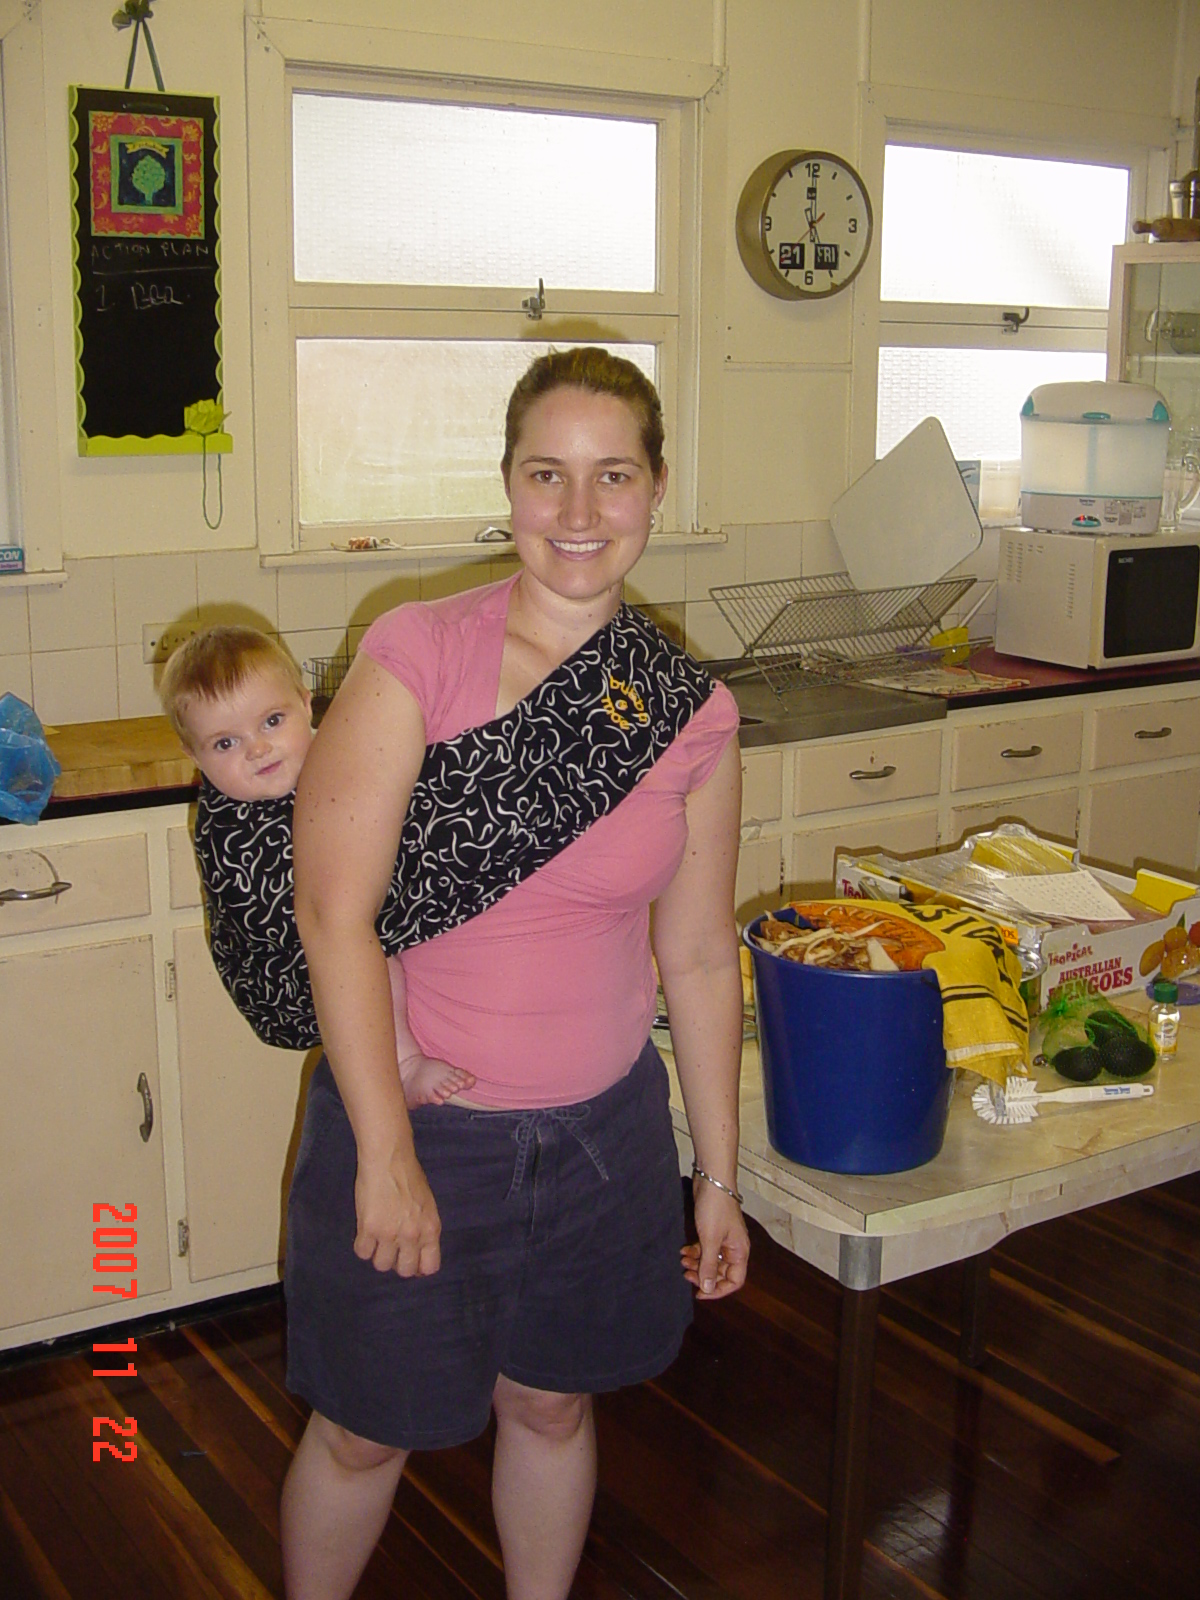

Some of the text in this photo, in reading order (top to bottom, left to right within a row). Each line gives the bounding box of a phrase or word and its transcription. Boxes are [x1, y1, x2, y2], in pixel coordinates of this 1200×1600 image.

[805, 163, 820, 178] 12
[848, 218, 857, 233] 3
[91, 241, 209, 265] ACTION PLAN
[780, 245, 801, 265] 21
[816, 246, 836, 263] FRI
[804, 270, 814, 286] 6
[1058, 956, 1122, 985] AUSTRALIAN
